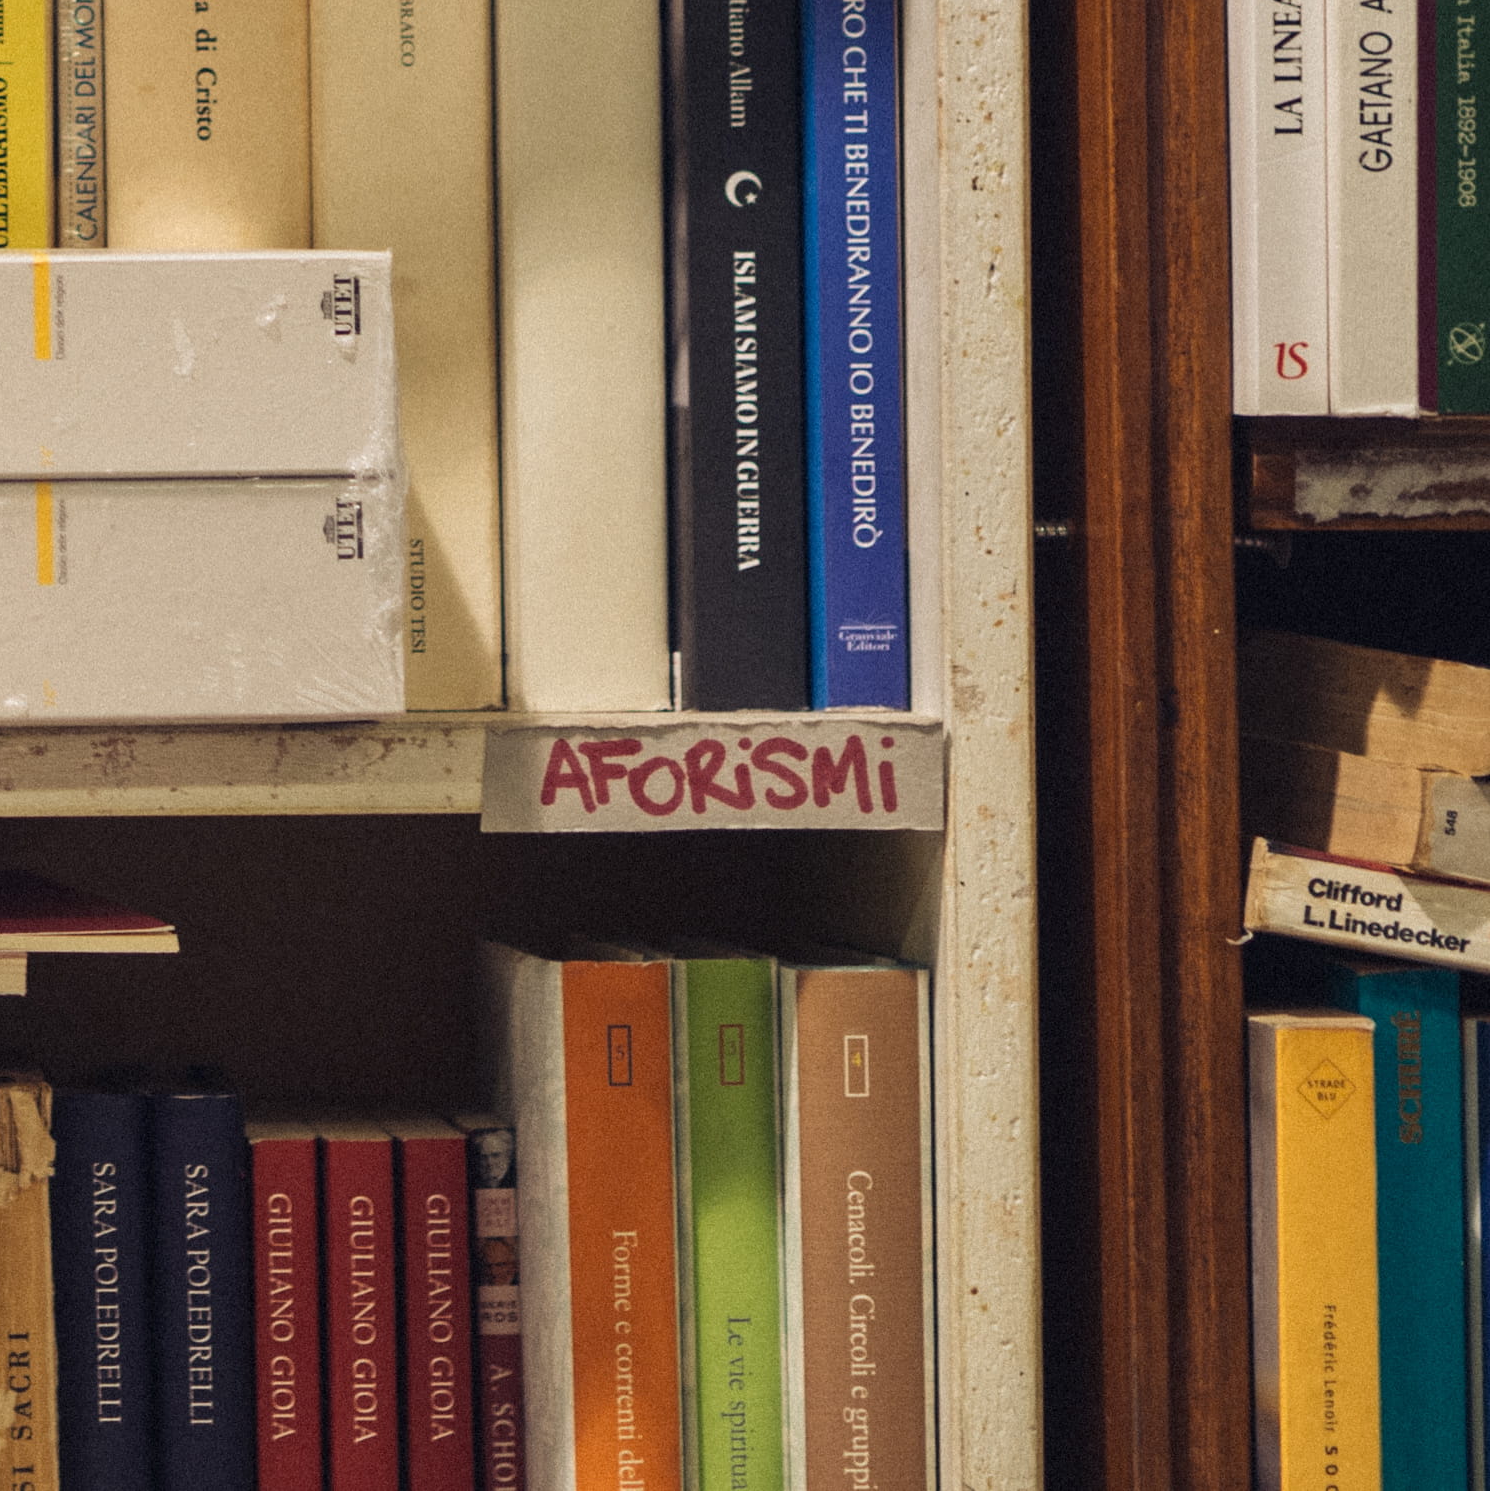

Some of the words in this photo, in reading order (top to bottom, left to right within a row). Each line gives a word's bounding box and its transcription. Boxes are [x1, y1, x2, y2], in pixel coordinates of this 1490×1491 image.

[844, 47, 867, 103] CHE
[1274, 97, 1303, 134] LA
[1359, 32, 1393, 172] GAETANO
[845, 110, 868, 133] TI
[845, 144, 872, 353] BENEDIRANNO
[734, 252, 756, 331] ISLAM
[736, 338, 757, 423] SIAMO
[850, 363, 873, 395] IO
[737, 431, 759, 459] IN
[848, 403, 878, 551] BENEDIRÒ
[737, 461, 759, 570] GUERRA
[1304, 905, 1325, 927] L.
[1327, 909, 1470, 952] Linedecker
[1308, 877, 1403, 912] Clifford
[847, 1170, 874, 1283] Cenacoli.
[268, 1193, 293, 1342] GIULIANO
[850, 1294, 875, 1375] Circoli
[271, 1355, 295, 1440] GIOIA
